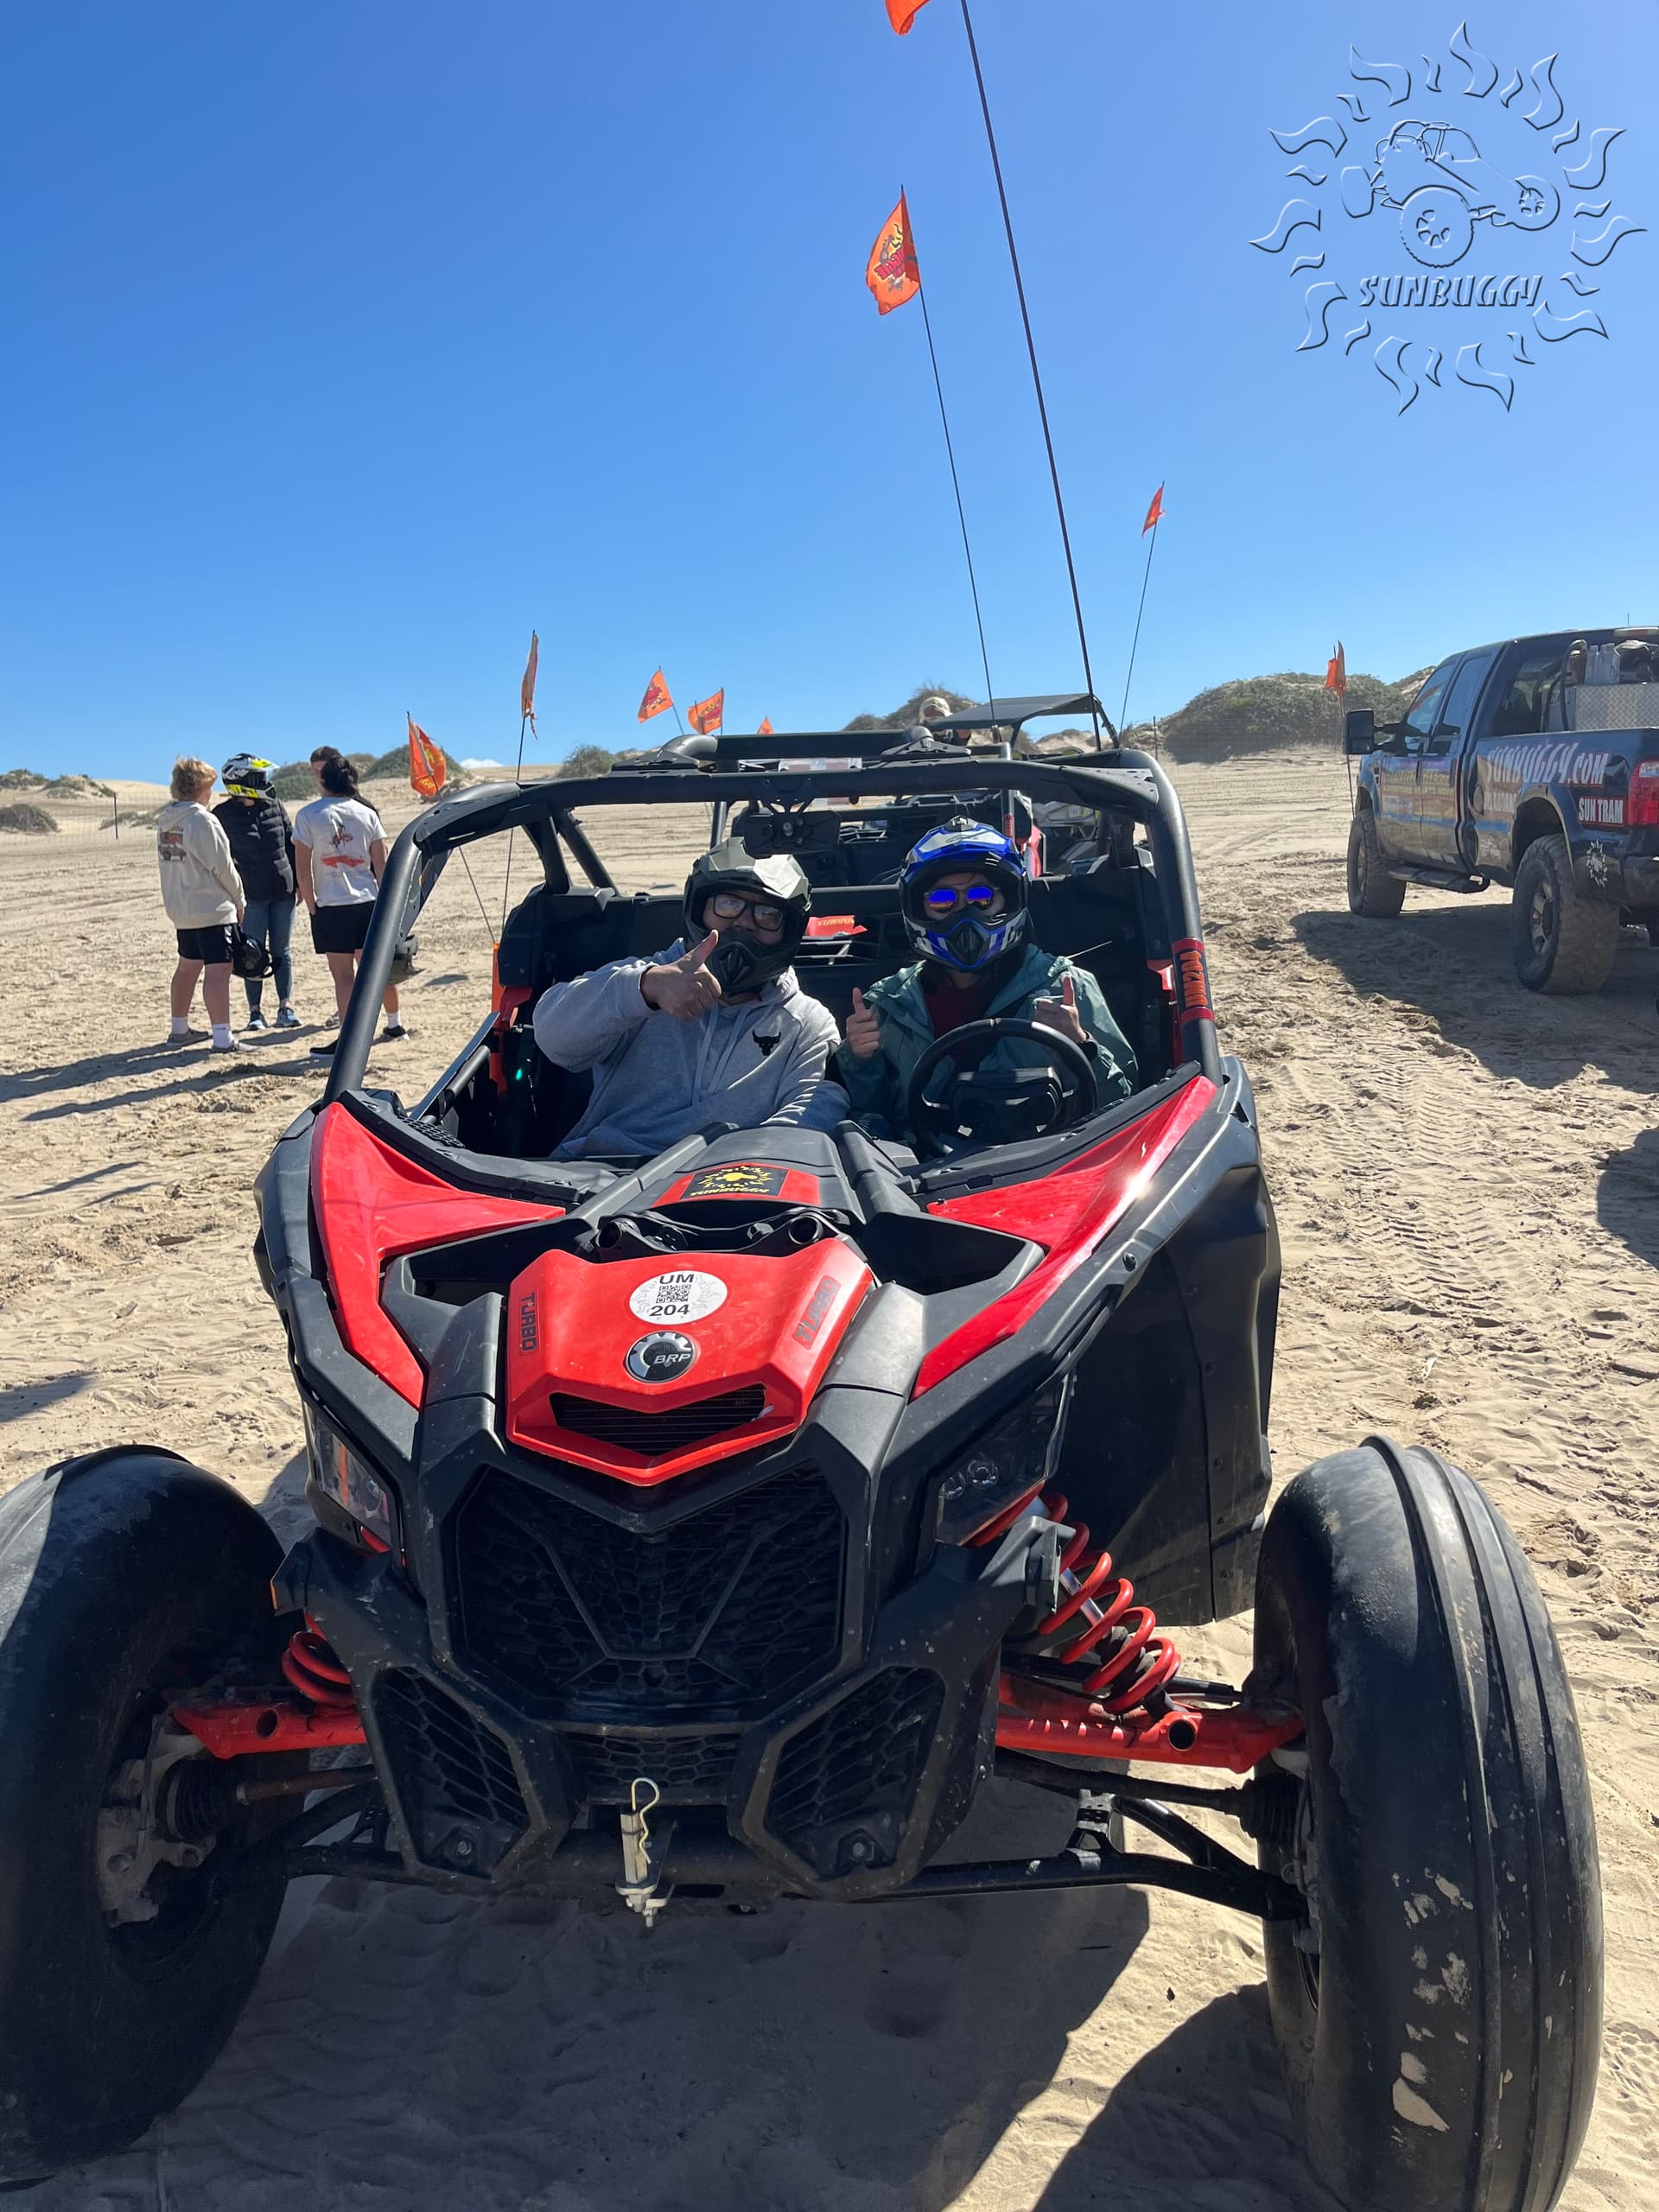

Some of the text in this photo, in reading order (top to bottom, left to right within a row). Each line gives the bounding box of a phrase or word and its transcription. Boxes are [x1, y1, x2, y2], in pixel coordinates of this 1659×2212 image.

[1579, 798, 1624, 824] SUN TRAM
[659, 1274, 695, 1285] UM
[649, 1304, 690, 1317] 204
[795, 1280, 835, 1341] TURBO
[520, 1292, 537, 1351] TURBO
[653, 1353, 691, 1364] BRP
